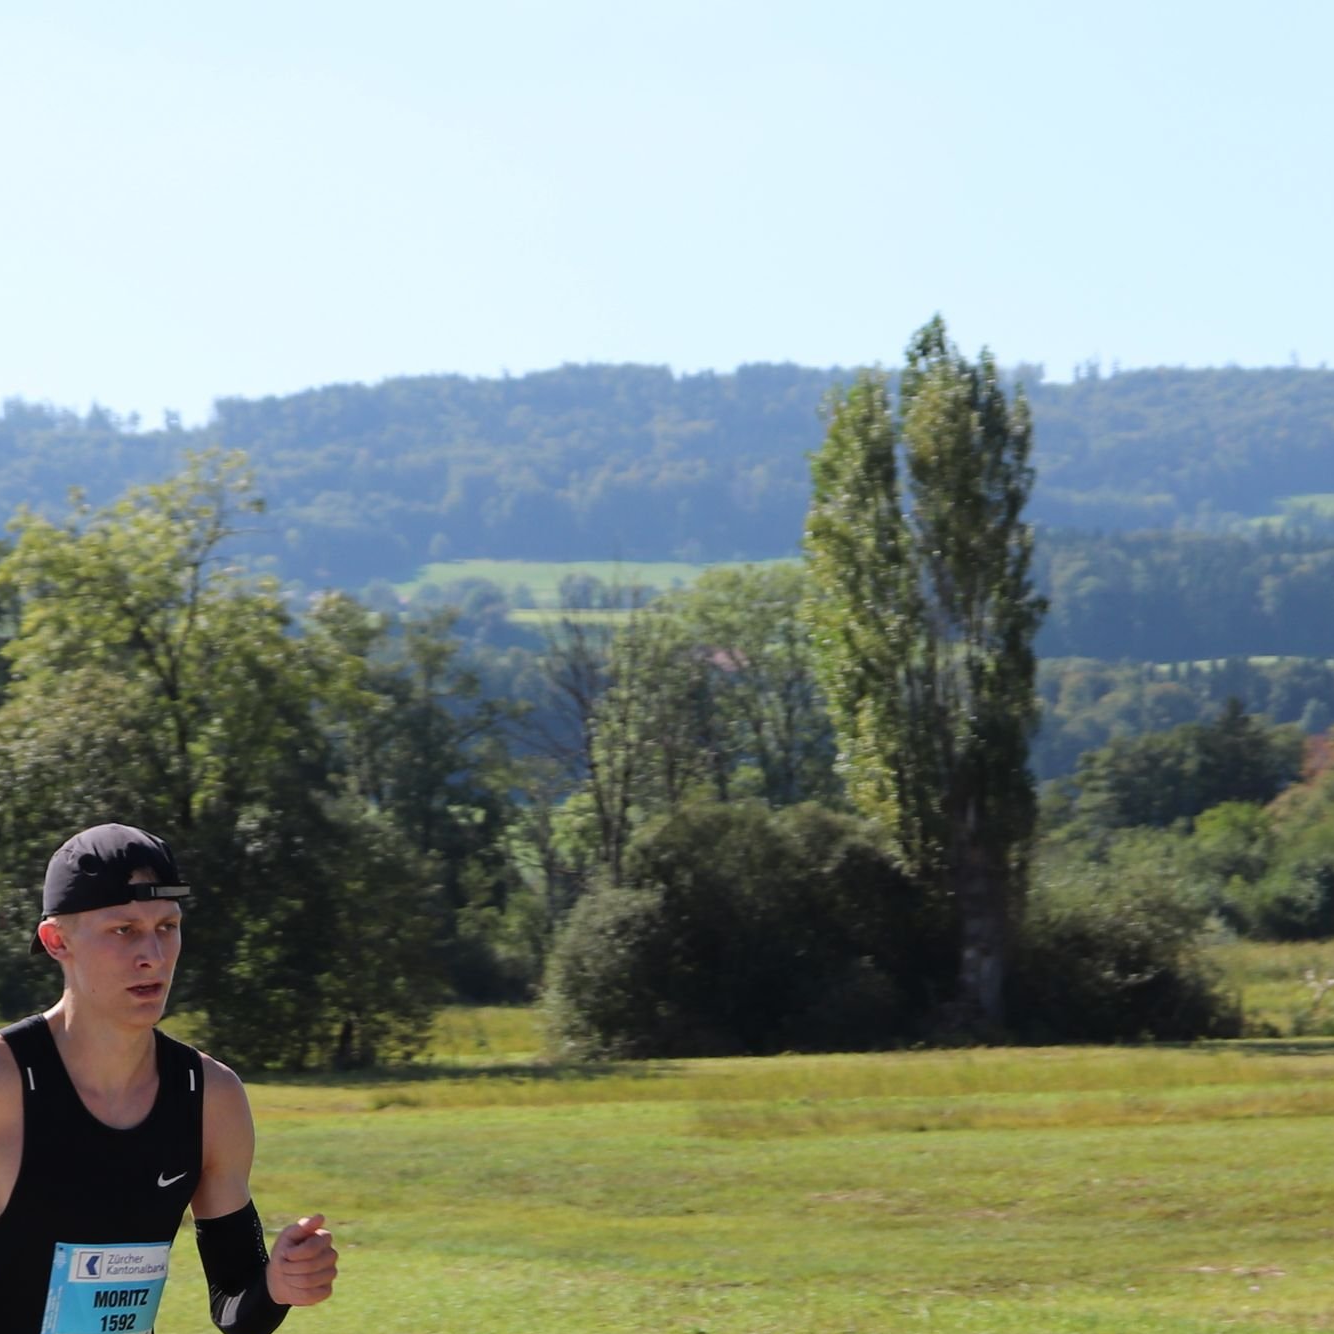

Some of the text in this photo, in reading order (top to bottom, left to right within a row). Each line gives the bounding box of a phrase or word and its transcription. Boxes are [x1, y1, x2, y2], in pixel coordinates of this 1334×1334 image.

[108, 1254, 144, 1264] Zürcher
[106, 1263, 165, 1275] Kantonalbank
[93, 1288, 150, 1308] MORITZ
[100, 1313, 137, 1332] 1592
